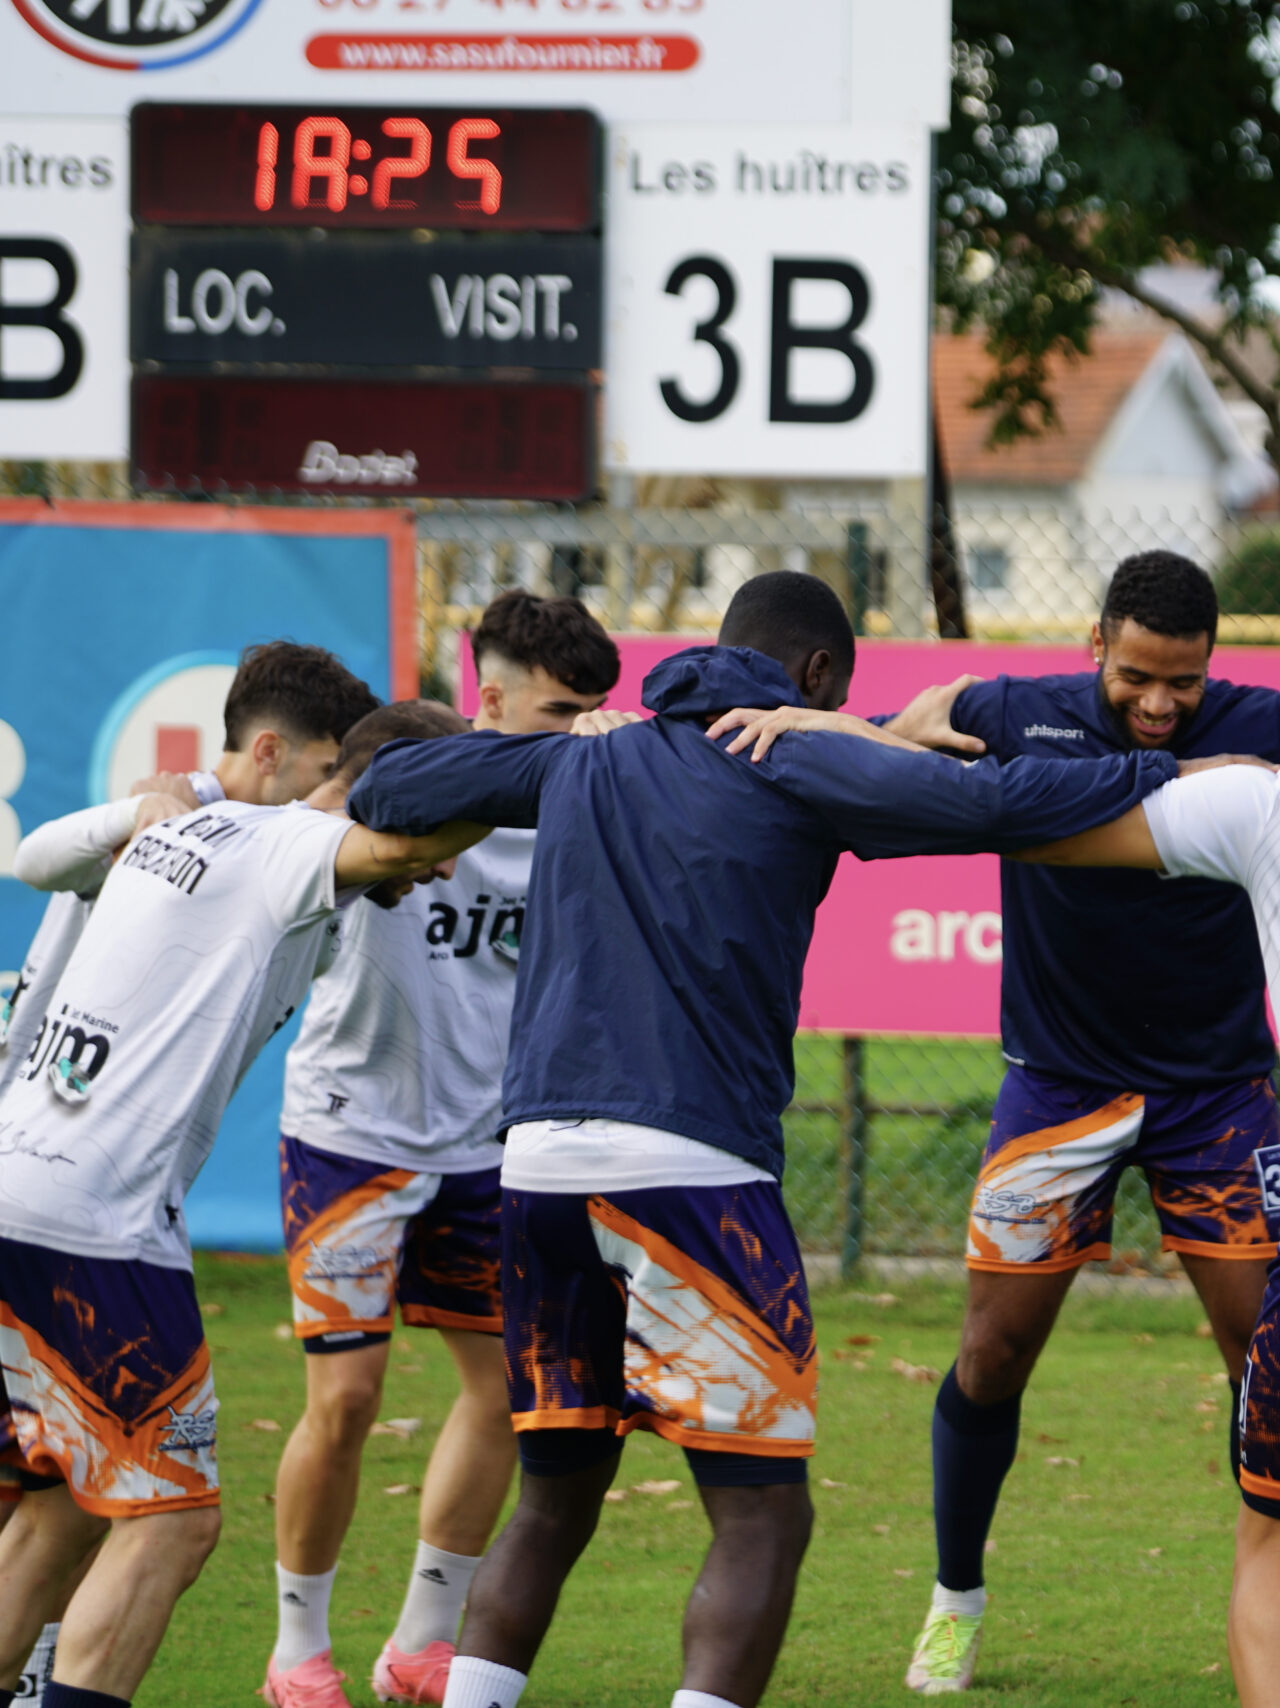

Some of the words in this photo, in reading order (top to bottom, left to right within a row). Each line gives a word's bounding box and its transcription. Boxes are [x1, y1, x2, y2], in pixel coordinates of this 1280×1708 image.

[0, 143, 113, 188] îtres
[629, 150, 717, 193] Les
[735, 149, 910, 193] huîtres
[162, 267, 287, 337] LOC.
[428, 272, 579, 341] VISIT.
[659, 254, 876, 423] 3B
[1024, 723, 1085, 740] uhlsport
